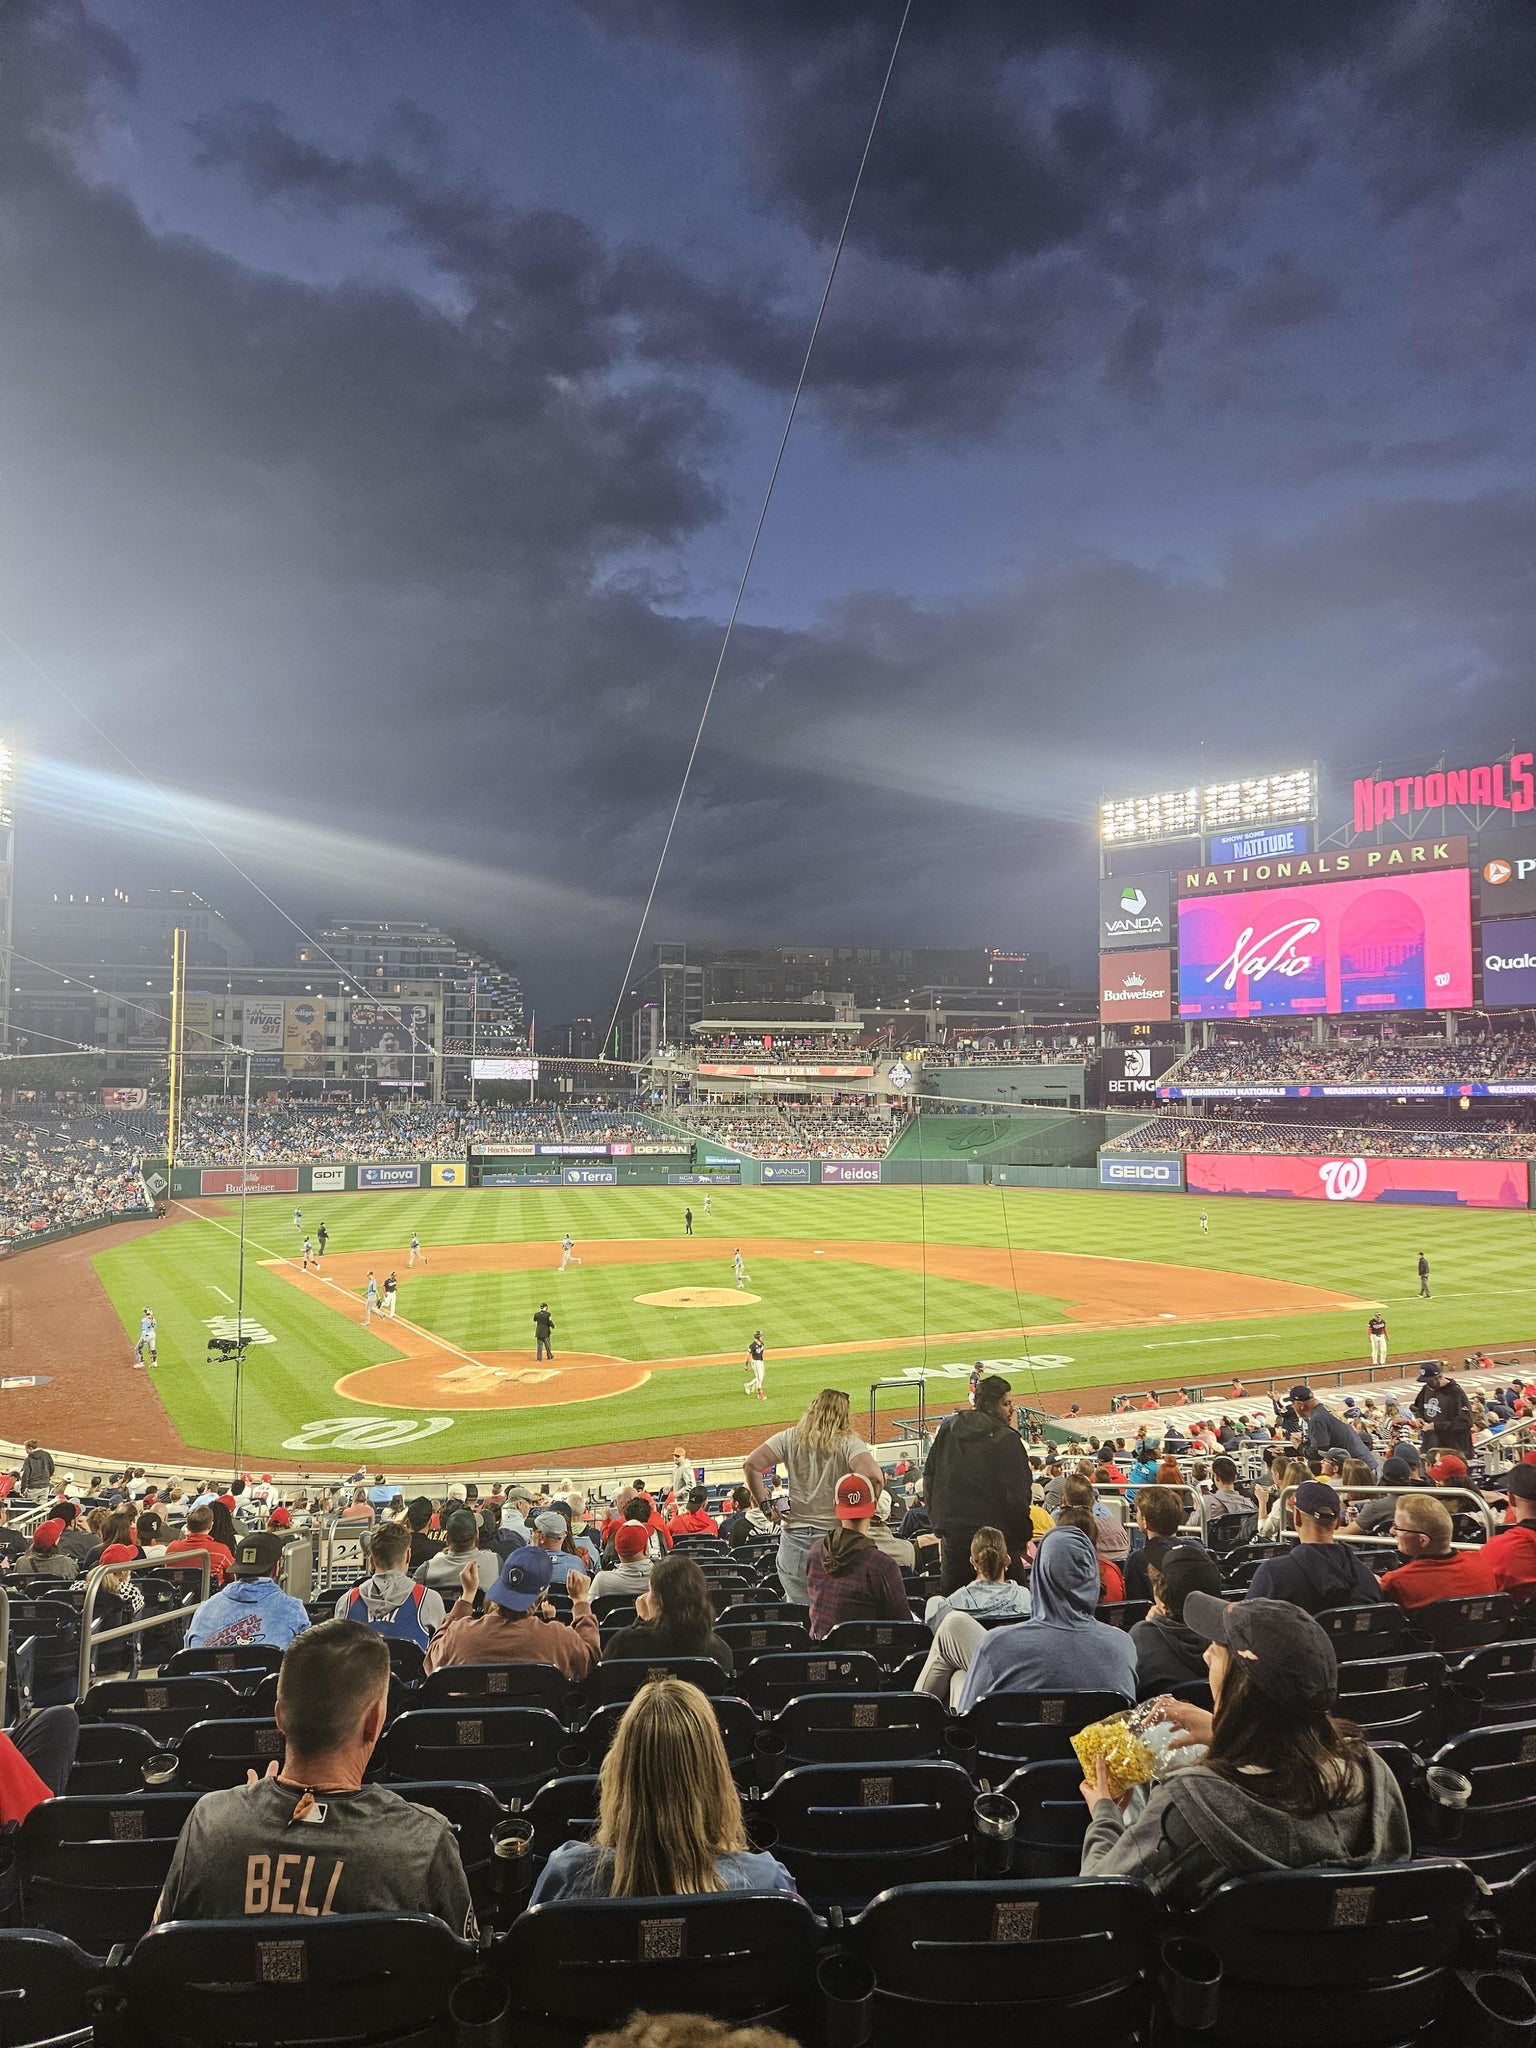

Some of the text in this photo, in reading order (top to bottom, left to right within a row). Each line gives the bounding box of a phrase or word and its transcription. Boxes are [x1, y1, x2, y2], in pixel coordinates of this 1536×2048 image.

[1353, 752, 1534, 833] NATIONALS
[1221, 830, 1265, 845] SHOW SOME
[1233, 831, 1295, 860] NATITUDE
[1185, 843, 1450, 888] NATIONALS PARK
[1514, 858, 1536, 880] P
[1105, 916, 1163, 932] VANDA
[1434, 972, 1451, 987] W
[1103, 988, 1166, 1002] Budweiser
[249, 1016, 282, 1025] HVAC
[261, 1025, 281, 1034] 911
[753, 1066, 769, 1075] THIS
[770, 1066, 790, 1075] BUD'S
[791, 1066, 806, 1075] FOR
[1181, 1087, 1286, 1097] WASHINGTON NATIONALS
[1323, 1086, 1445, 1095] WASHINGTON NATIONALS
[487, 1146, 533, 1154] Harris Teeter
[661, 1145, 687, 1153] FAN
[313, 1171, 344, 1179] GDIT
[380, 1169, 413, 1180] Inova
[581, 1171, 613, 1182] Terra
[841, 1167, 879, 1180] leidos
[1109, 1165, 1170, 1180] GEICO
[1318, 1157, 1368, 1201] W
[225, 1183, 276, 1193] Budweiser
[281, 1417, 455, 1451] W
[848, 1491, 861, 1505] W
[246, 1550, 254, 1560] T
[244, 1853, 344, 1917] BELL
